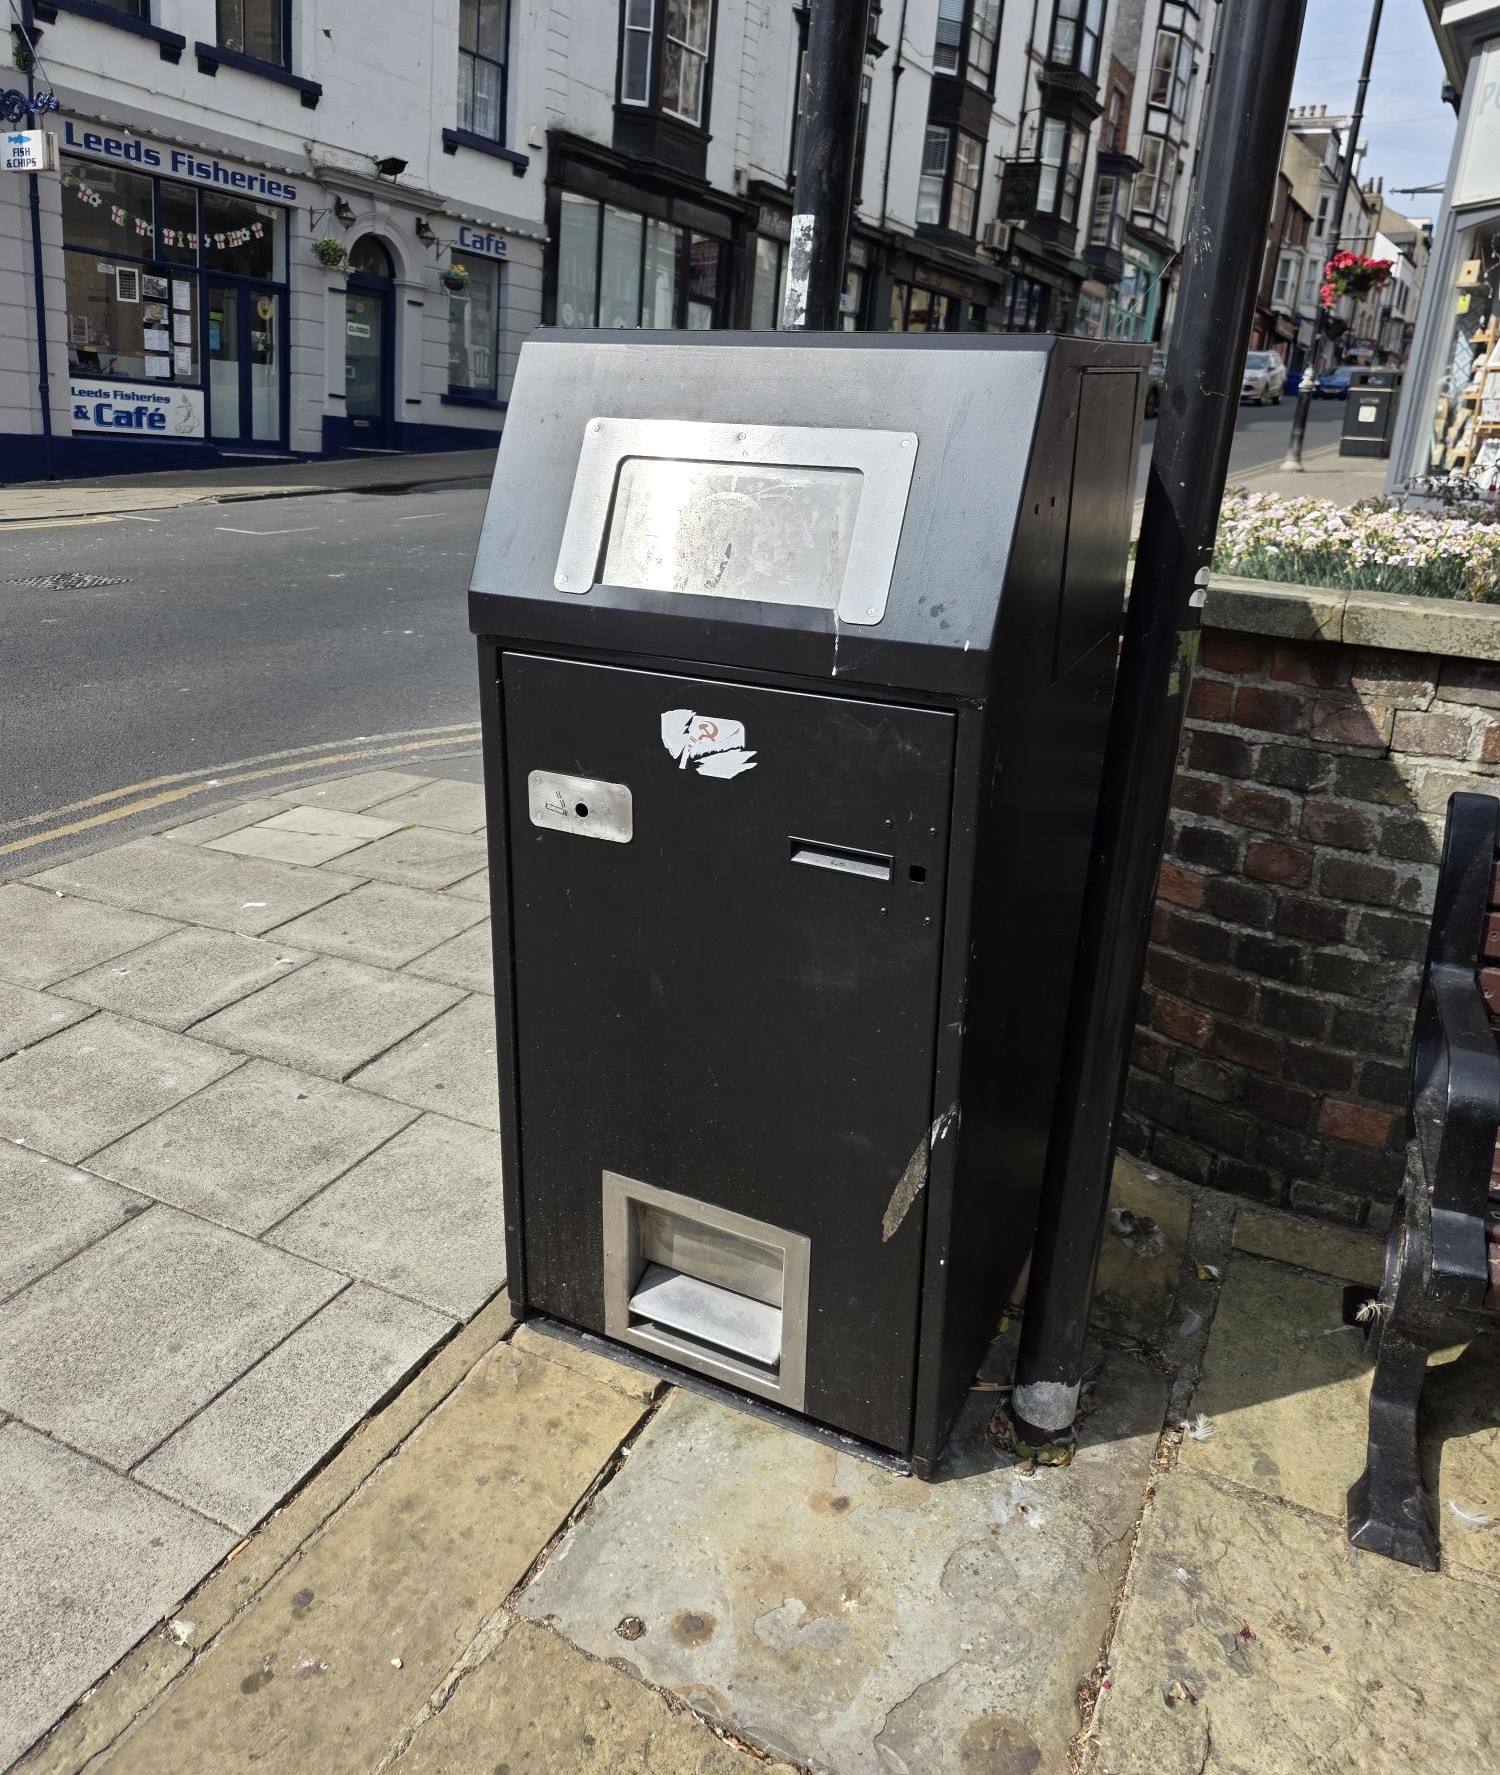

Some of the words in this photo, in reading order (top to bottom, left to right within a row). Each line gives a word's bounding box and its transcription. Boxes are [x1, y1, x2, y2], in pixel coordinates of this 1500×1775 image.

[12, 147, 31, 157] FISH
[64, 121, 161, 167] Leeds
[171, 150, 297, 201] Fisheries
[459, 226, 507, 256] Café
[71, 387, 110, 399] Leeds
[113, 390, 171, 404] Fisheries
[73, 404, 90, 421] &
[94, 403, 167, 431] Café
